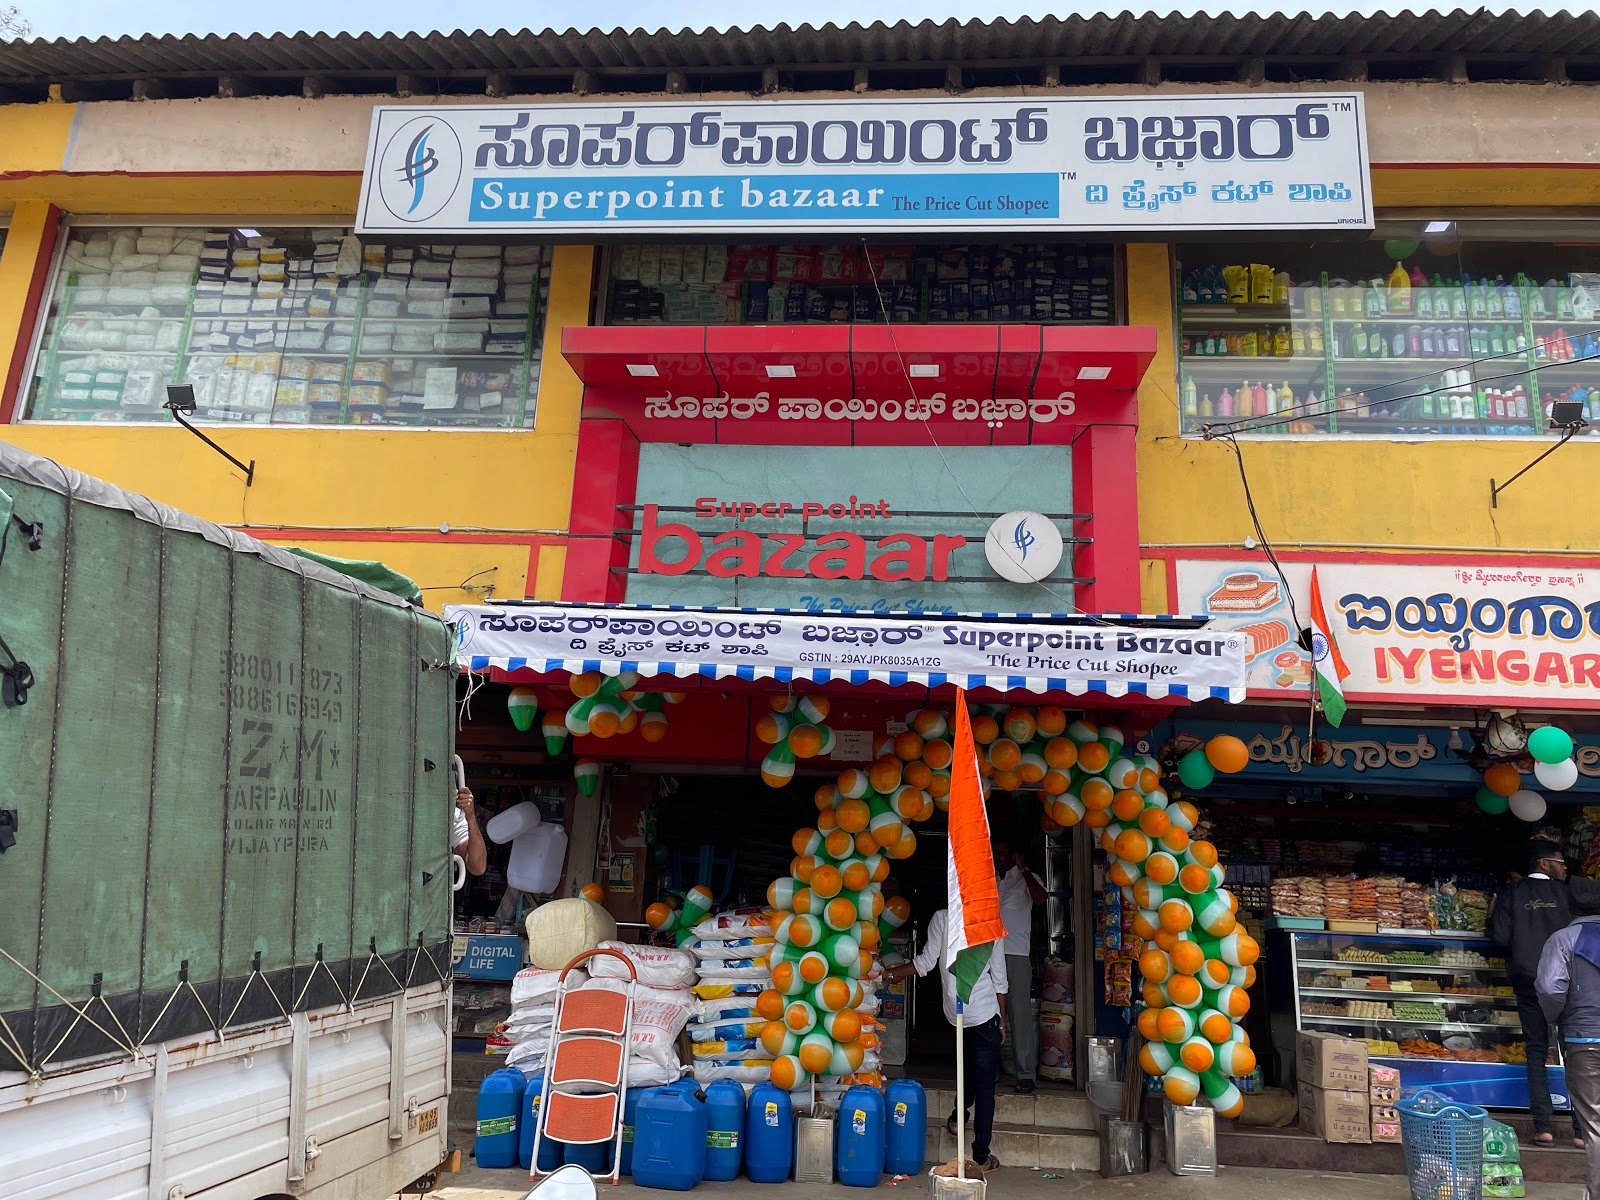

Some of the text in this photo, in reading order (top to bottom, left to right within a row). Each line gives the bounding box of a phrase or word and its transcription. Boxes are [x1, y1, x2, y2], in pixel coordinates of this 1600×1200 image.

[480, 178, 885, 219] Superpoint bazaar
[892, 196, 920, 211] The
[925, 196, 961, 211] Price
[965, 195, 992, 211] Cut
[996, 195, 1050, 215] Shopee
[1085, 179, 1352, 211] ದಿ ಪ್ರೈಸ್ ಕಟ್ ಶಾಪಿ
[644, 390, 770, 419] ಸೂಪರ್
[778, 392, 947, 421] ಪಾಯಿಂಟ್
[695, 495, 893, 523] Super point
[637, 503, 967, 582] bazaar
[799, 596, 825, 610] The
[871, 598, 901, 611] Cut
[570, 637, 769, 657] ದಿ ಪ್ರೈಸ್ ಕಟ್ ಶಾಪಿ
[943, 625, 1104, 653] Superpoint
[799, 652, 832, 663] GSTIN
[841, 654, 941, 667] 29AYJPK8035A1ZG
[986, 653, 1178, 680] The Price Cut Shopee
[1374, 647, 1600, 689] IYENGAR
[469, 958, 495, 970] LIFE
[471, 946, 516, 958] DIGITAL
